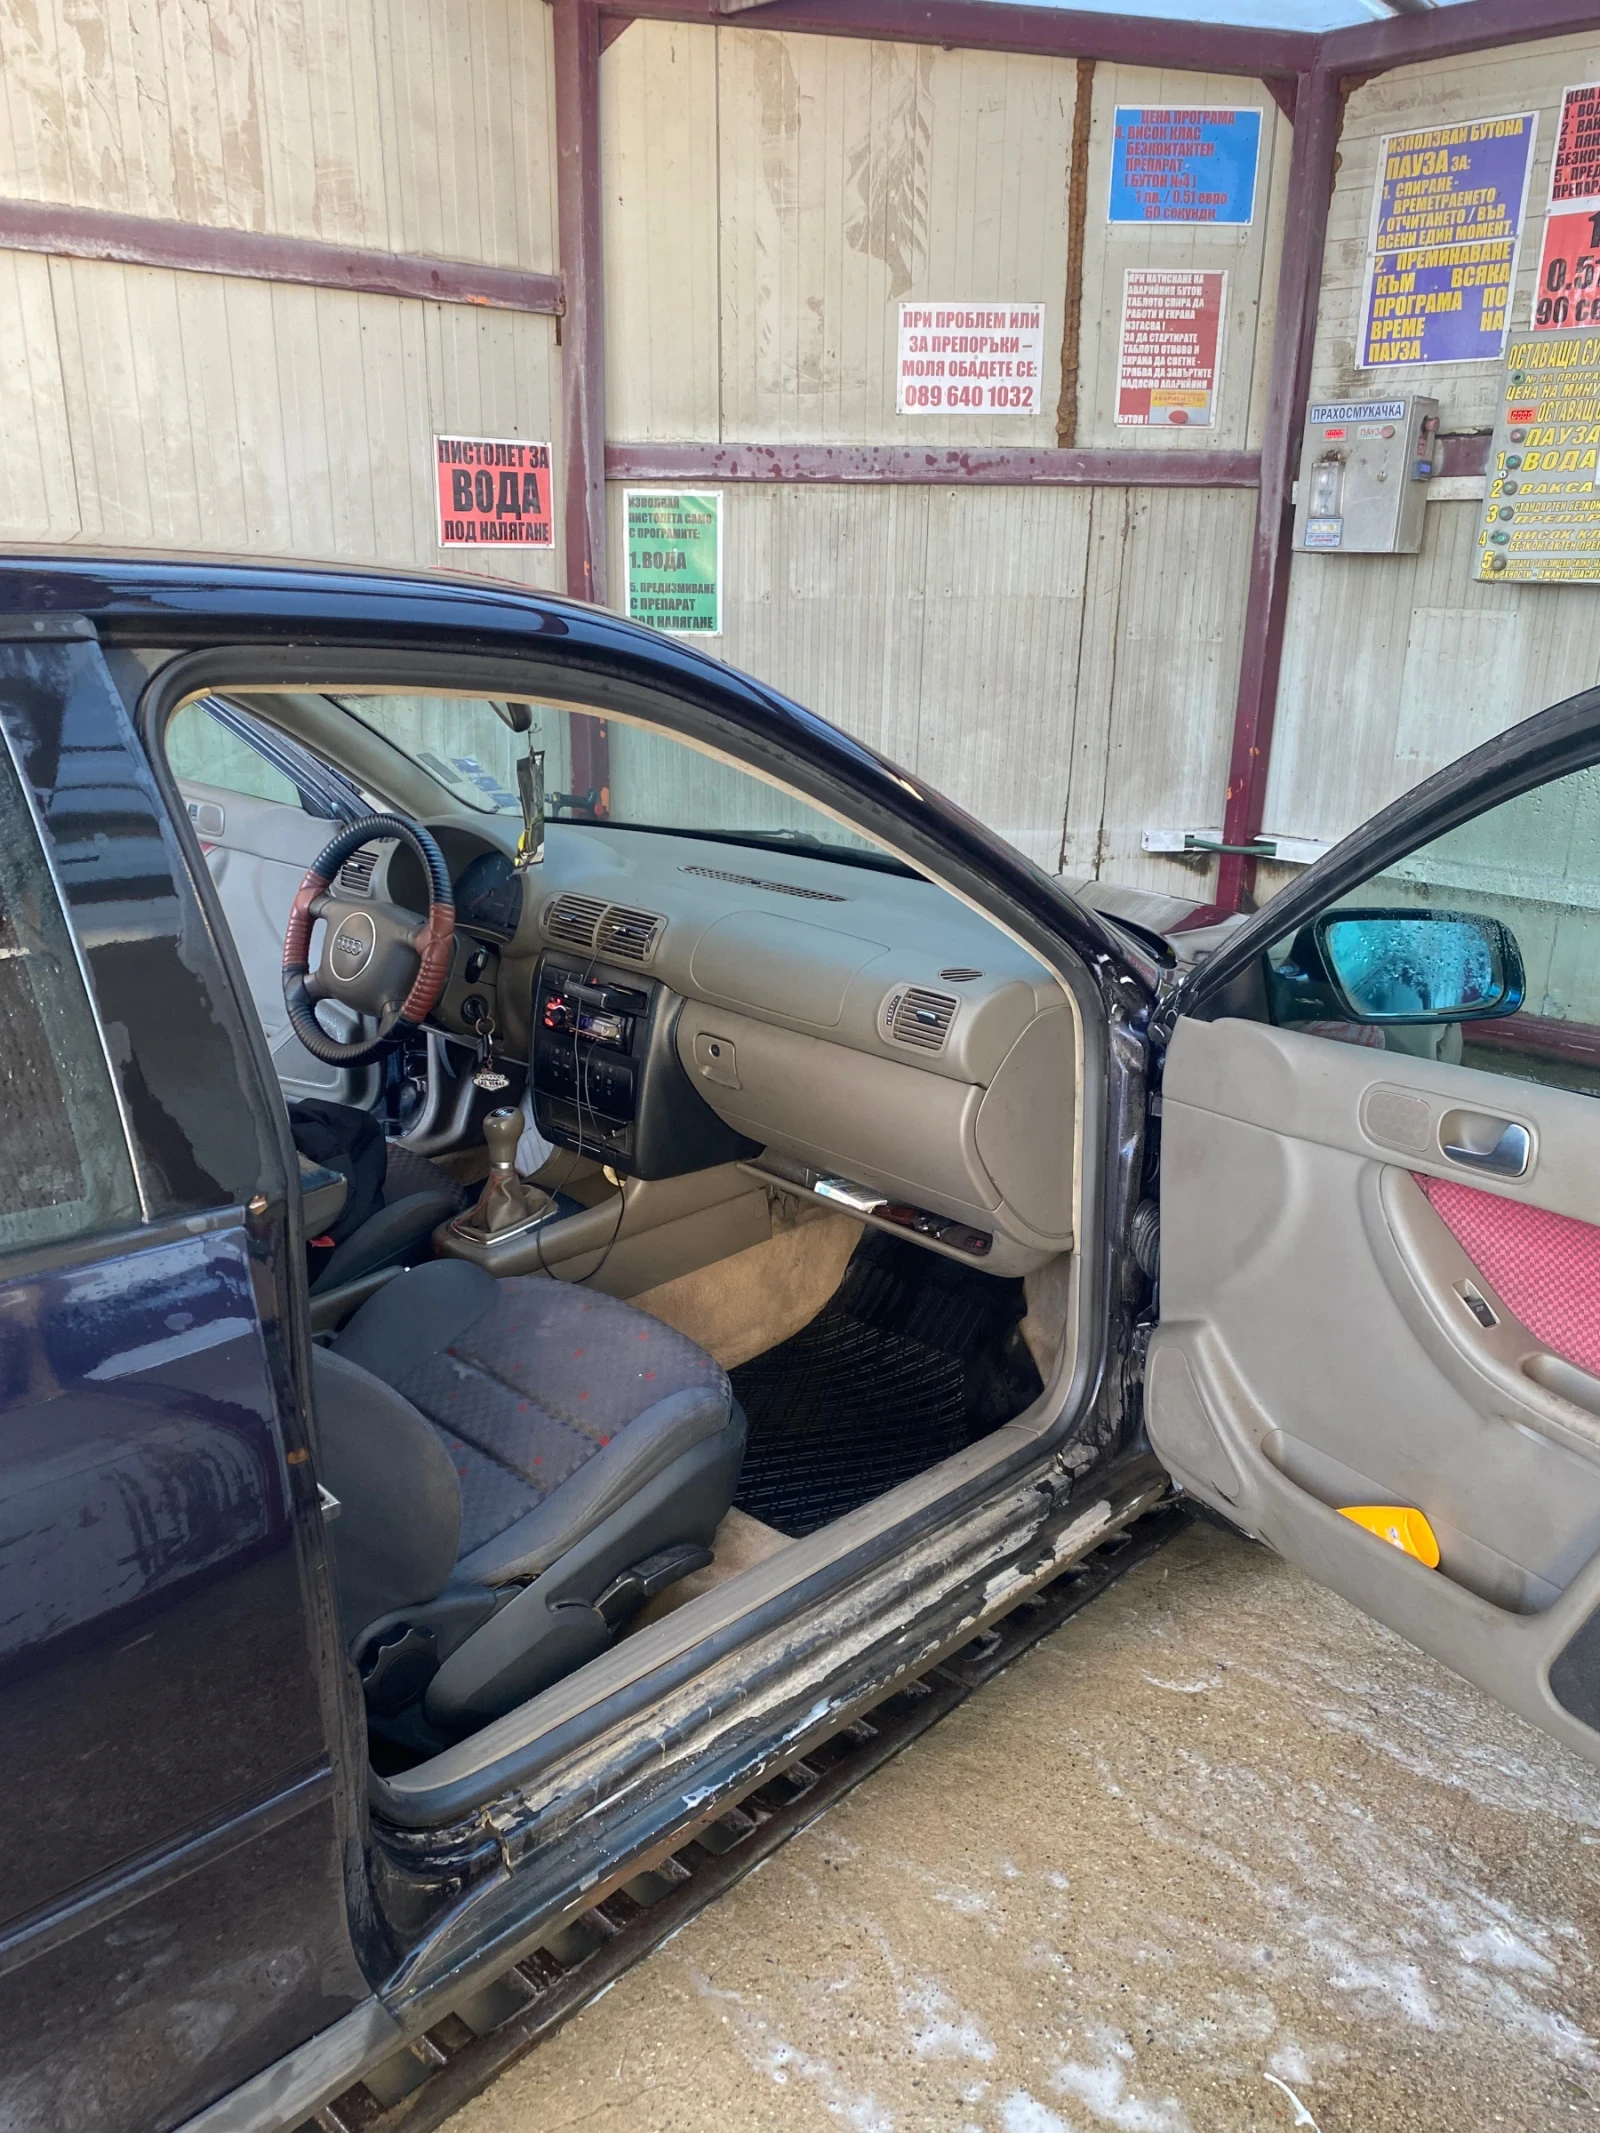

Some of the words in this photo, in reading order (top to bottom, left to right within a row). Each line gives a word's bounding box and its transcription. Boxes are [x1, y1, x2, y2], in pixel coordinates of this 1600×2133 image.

[1565, 88, 1595, 105] ЦЕНА
[1141, 110, 1170, 125] ЦЕНА
[1174, 110, 1235, 125] ПРОГРАМА
[1115, 126, 1125, 139] 4.
[1128, 126, 1166, 140] ВИСОК
[1170, 127, 1201, 140] КЛАС
[1470, 118, 1523, 142] БУТОНА
[1126, 142, 1215, 156] БЕЗКОНТАКТЕН
[1126, 158, 1183, 172] ПРЕПАРАТ
[1386, 150, 1448, 180] ПАУЗА
[1451, 155, 1471, 172] ЗА:
[1131, 174, 1168, 188] БУТОН
[1383, 185, 1391, 199] 1.
[1395, 176, 1453, 198] СПИРАНЕ
[1198, 193, 1228, 205] евро
[1393, 187, 1496, 215] ВРЕМЕТРАЕНЕТО
[1145, 206, 1160, 219] 60
[1163, 208, 1216, 221] секунди
[1387, 209, 1466, 232] ОТЧИТАНЕТО
[1477, 204, 1506, 221] ВЪВ
[1377, 231, 1416, 249] ВСЕКИ
[1419, 227, 1453, 247] ЕДИН
[1455, 220, 1513, 241] МОМЕНТ.
[1374, 257, 1387, 273] 2.
[1396, 241, 1511, 271] ПРЕМИНАВАНЕ
[1129, 274, 1145, 283] ПРИ
[1146, 274, 1192, 284] НАТИСКАНЕ
[1194, 274, 1204, 284] НА
[1376, 272, 1416, 295] КЪМ
[1451, 263, 1510, 288] ВСЯКА
[1177, 286, 1202, 296] БУТОН
[1127, 297, 1163, 307] ТАБЛОТО
[1165, 298, 1191, 307] СПИРА
[1192, 298, 1204, 308] ДА
[1373, 291, 1463, 318] ПРОГРАМА
[1482, 287, 1507, 308] ПО
[1536, 296, 1569, 325] 90
[903, 311, 932, 328] ПРИ
[935, 312, 1006, 329] ПРОБЛЕМ
[1009, 312, 1040, 329] ИЛИ
[1126, 309, 1157, 319] РАБОТИ
[1165, 309, 1195, 319] ЕКРАНА
[1125, 321, 1160, 331] ИЗГАСВА
[1370, 317, 1426, 340] ВРЕМЕ
[1480, 310, 1503, 332] НА
[909, 335, 928, 353] ЗА
[931, 336, 1019, 353] ПРЕПОРЪКИ
[1124, 332, 1134, 342] ЗА
[1136, 333, 1148, 343] ДА
[1149, 333, 1198, 343] СТАРТИРАТЕ
[1123, 344, 1159, 354] ТАБЛОТО
[1161, 344, 1192, 354] ОТНОВО
[1368, 340, 1421, 363] ПАУЗА
[1507, 339, 1581, 371] ОСТАВАЩА
[902, 360, 945, 376] МОЛЯ
[948, 361, 1013, 379] ОБАДЕТЕ
[1016, 361, 1037, 377] СЕ:
[1122, 356, 1152, 366] ЕКРАНА
[1153, 356, 1165, 366] ДА
[1166, 356, 1196, 366] СВЕТНЕ
[1122, 367, 1152, 377] ТРЯБВА
[1153, 368, 1165, 378] ДА
[1166, 368, 1212, 378] ЗАВЪРТИТЕ
[1539, 373, 1554, 383] НА
[1121, 379, 1159, 389] НАДЯСНО
[1505, 384, 1539, 402] ЦЕНА
[1541, 383, 1559, 399] НА
[905, 385, 942, 407] 089
[947, 385, 983, 407] 640
[988, 385, 1034, 407] 1032
[1118, 414, 1144, 424] БУТОН
[1313, 404, 1402, 421] ПРАХОСМУКАЧКА
[1524, 424, 1600, 447] ПАУЗА
[438, 440, 525, 467] ПИСТОЛЕТ
[529, 445, 549, 468] ЗА
[1497, 451, 1506, 470] 1
[1521, 449, 1598, 472] ВОДА
[452, 468, 541, 520] ВОДА
[1490, 479, 1504, 498] 2
[1518, 481, 1593, 495] ВАКСА
[629, 512, 683, 524] ПИСТОЛЕТА
[685, 513, 712, 525] САМО
[1485, 504, 1499, 523] 3
[1514, 501, 1567, 513] СТАНДАРТЕН
[445, 520, 477, 542] ПОД
[480, 521, 549, 542] НАЛЯГАНЕ
[629, 527, 636, 538] С
[1478, 529, 1488, 548] 4
[1512, 529, 1574, 541] ВИСОК
[1508, 540, 1576, 552] БЕЗКОНТАКТЕН
[1480, 550, 1495, 569] 5
[630, 582, 638, 592] 5.
[640, 582, 715, 594] ПРЕДИЗМИВАНЕ
[630, 597, 638, 609] С
[640, 598, 696, 611] ПРЕПАРАТ
[657, 615, 713, 629] НАЛЯГАНЕ
